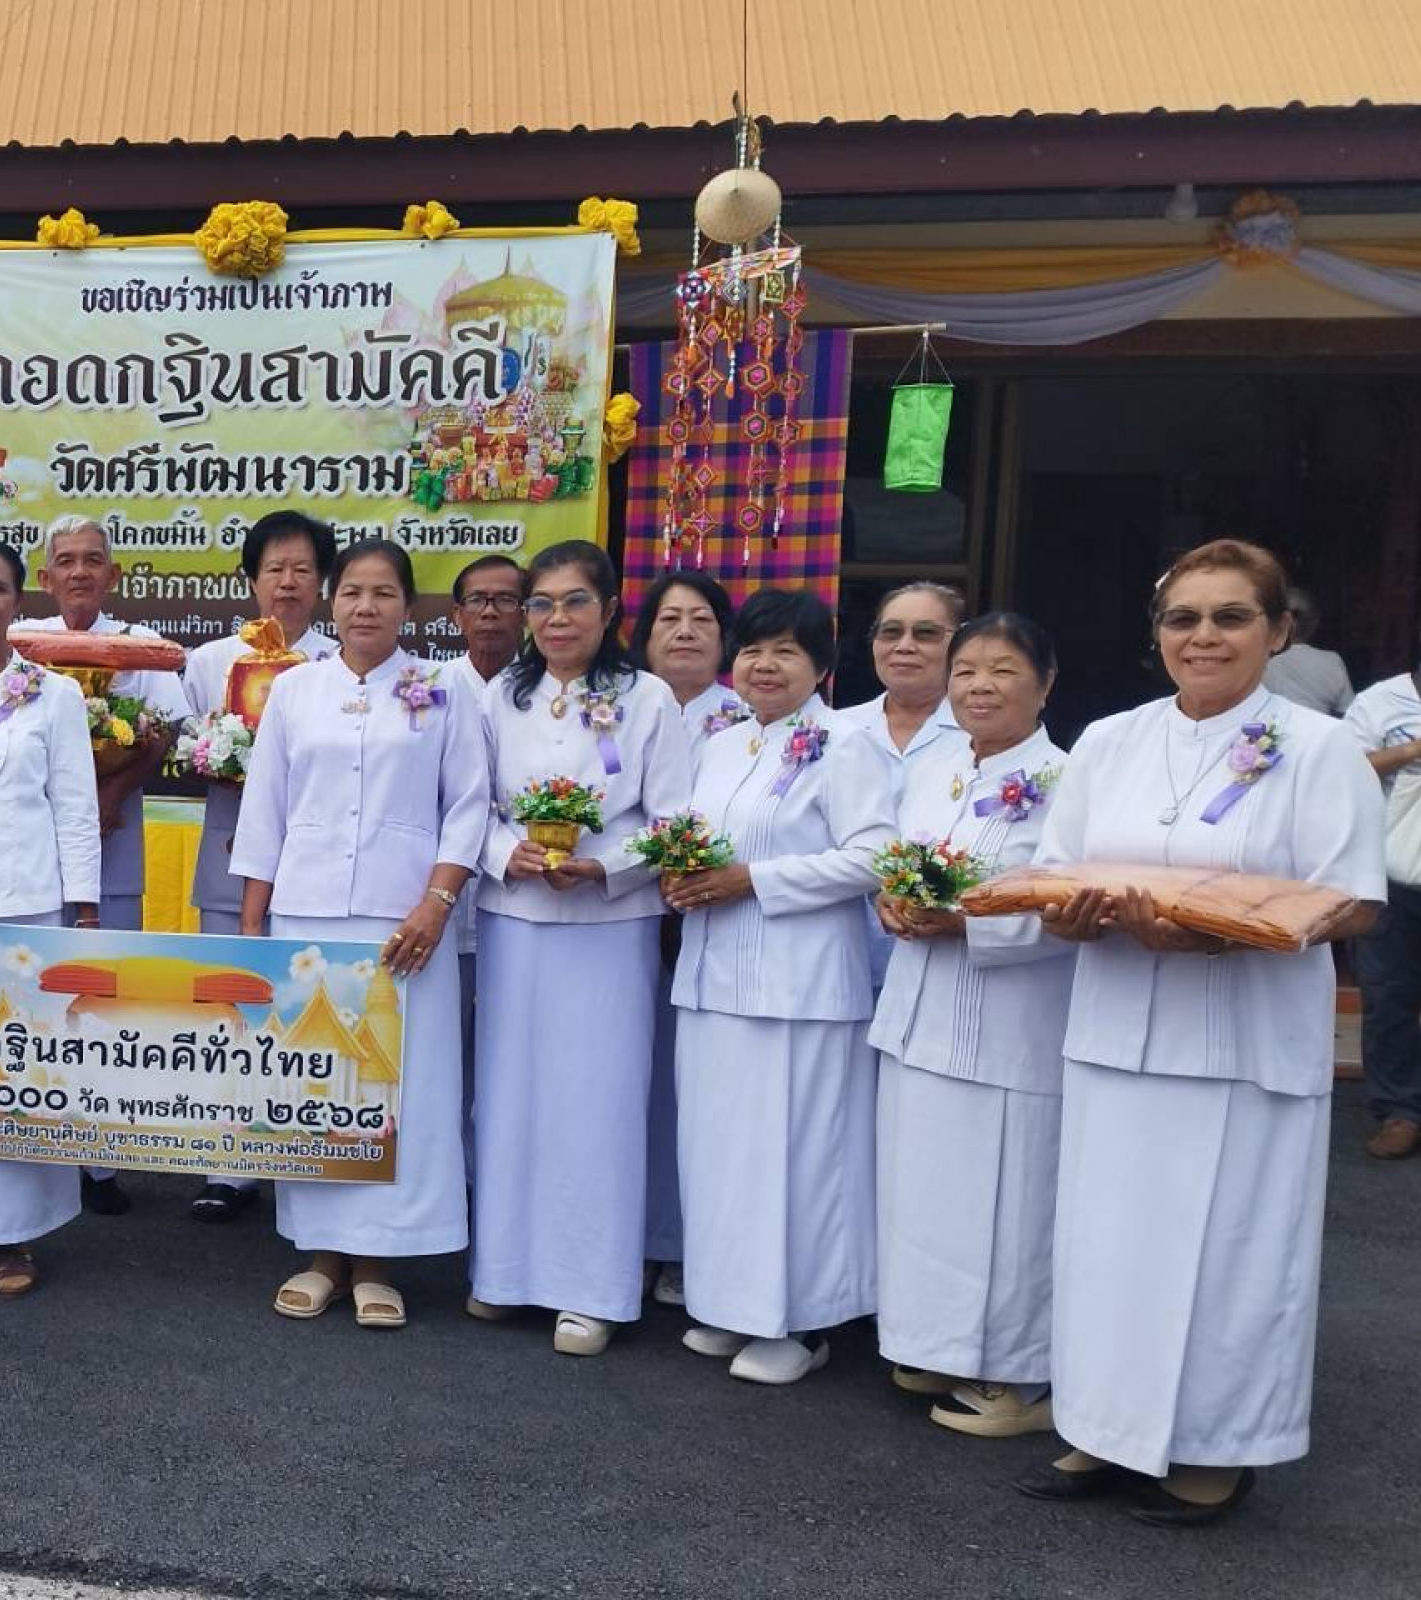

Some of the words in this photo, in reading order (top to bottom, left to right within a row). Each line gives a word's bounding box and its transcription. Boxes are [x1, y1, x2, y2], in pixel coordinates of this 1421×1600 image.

[81, 270, 393, 313] ขอเชิญร่วมเปนเจ้าภาพ
[50, 442, 406, 493] วัดศรีพัฒนาราม
[397, 517, 519, 546] จังหวัดเลย
[79, 1088, 108, 1113] วัด
[118, 1094, 253, 1125] พุทธศักราช
[266, 1098, 384, 1128] ๒๕๖๘
[104, 1131, 185, 1151] บูชาธรรม
[222, 1132, 234, 1152] ปี
